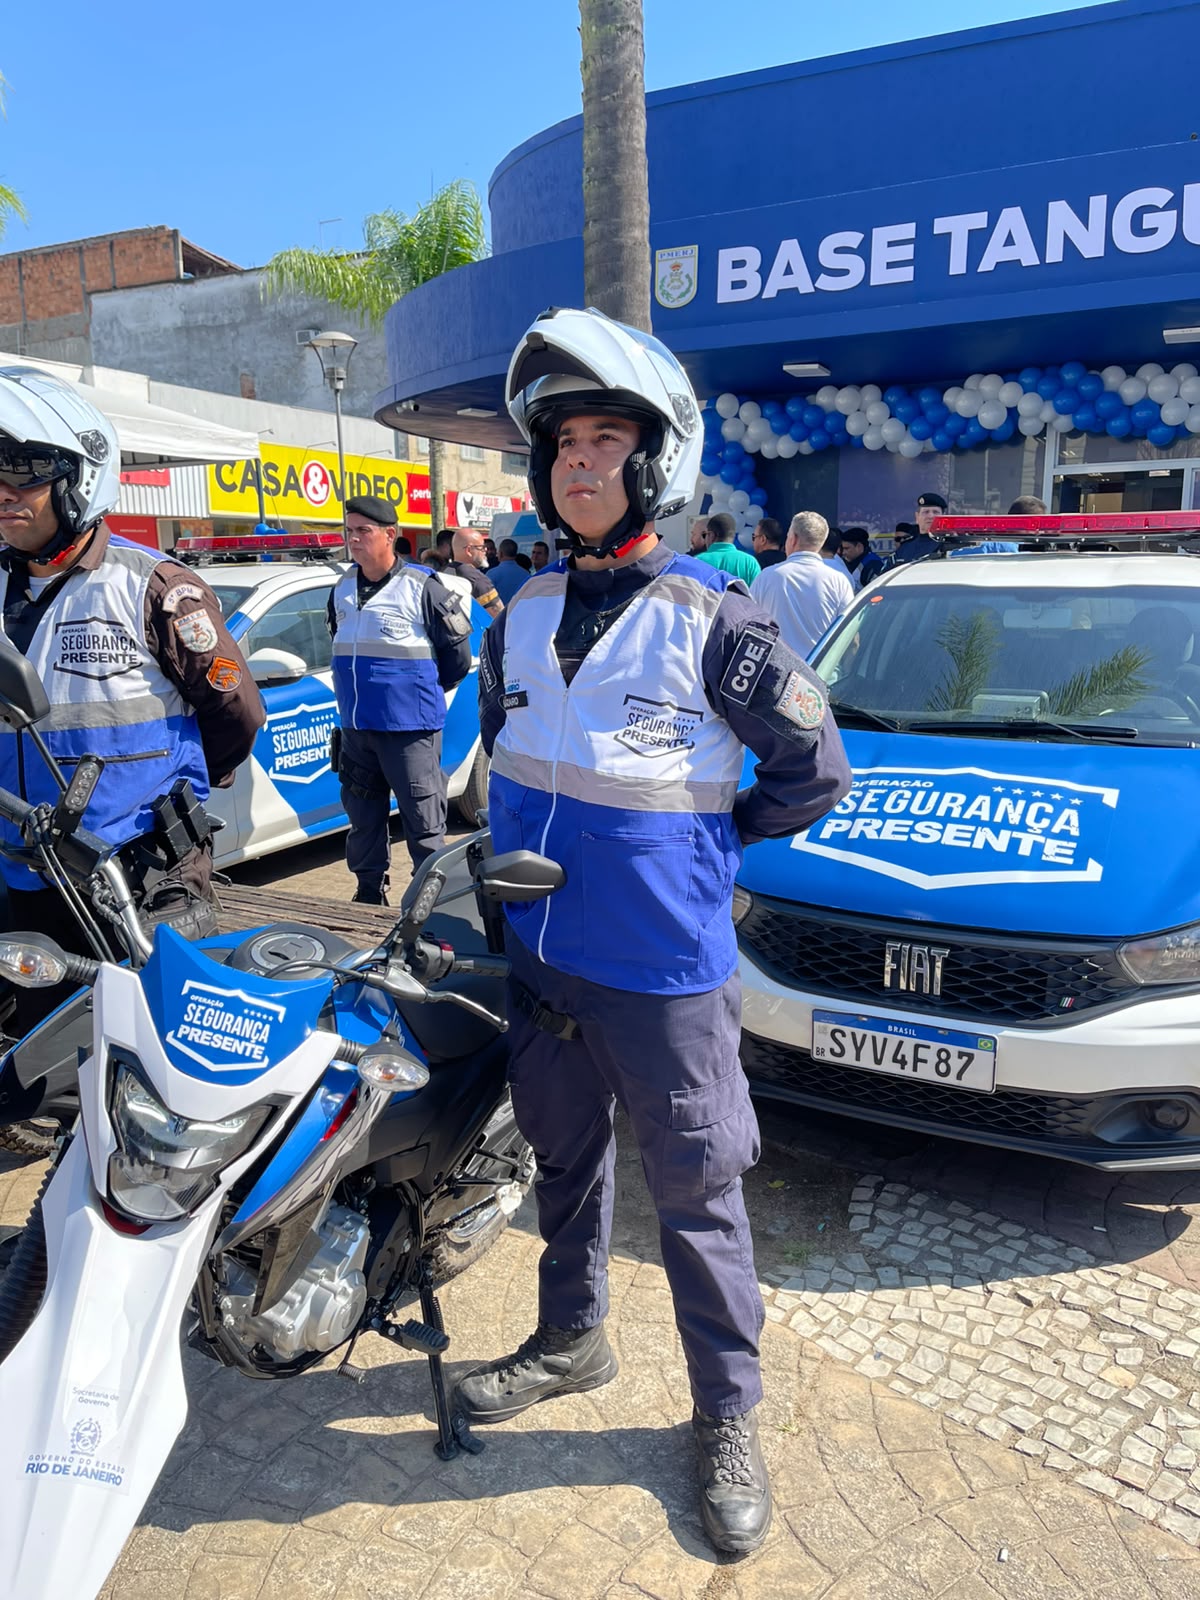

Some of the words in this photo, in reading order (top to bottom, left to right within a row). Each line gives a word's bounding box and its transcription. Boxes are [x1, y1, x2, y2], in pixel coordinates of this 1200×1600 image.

[717, 222, 916, 303] BASE
[933, 183, 1200, 276] TANG
[61, 634, 137, 654] SEGURANÇA
[61, 652, 137, 664] PRESENTE
[731, 642, 766, 692] COE
[271, 722, 297, 732] OPERAÇÃO
[622, 729, 688, 748] PRESENTE
[275, 745, 332, 771] PRESENT
[851, 780, 934, 788] OPERAÇÃO
[834, 789, 1080, 837] SEGURANÇA
[820, 818, 1077, 865] PRESENTE
[884, 941, 950, 995] FIAT
[190, 995, 224, 1008] OPERAÇÃO
[183, 1003, 270, 1043] SEGURANÇA
[888, 1025, 917, 1036] BRASIL
[177, 1024, 265, 1060] PRESENTE
[816, 1047, 826, 1057] BR
[829, 1028, 975, 1081] SYV4F87
[72, 1387, 109, 1400] Secretaria
[110, 1392, 119, 1401] de
[78, 1396, 110, 1408] Governo
[25, 1462, 50, 1474] RIO
[51, 1463, 71, 1475] DE
[72, 1466, 123, 1487] JANEIRO
[28, 1454, 75, 1464] GOVERNO
[79, 1458, 92, 1466] DO
[95, 1461, 126, 1475] ESTADO
